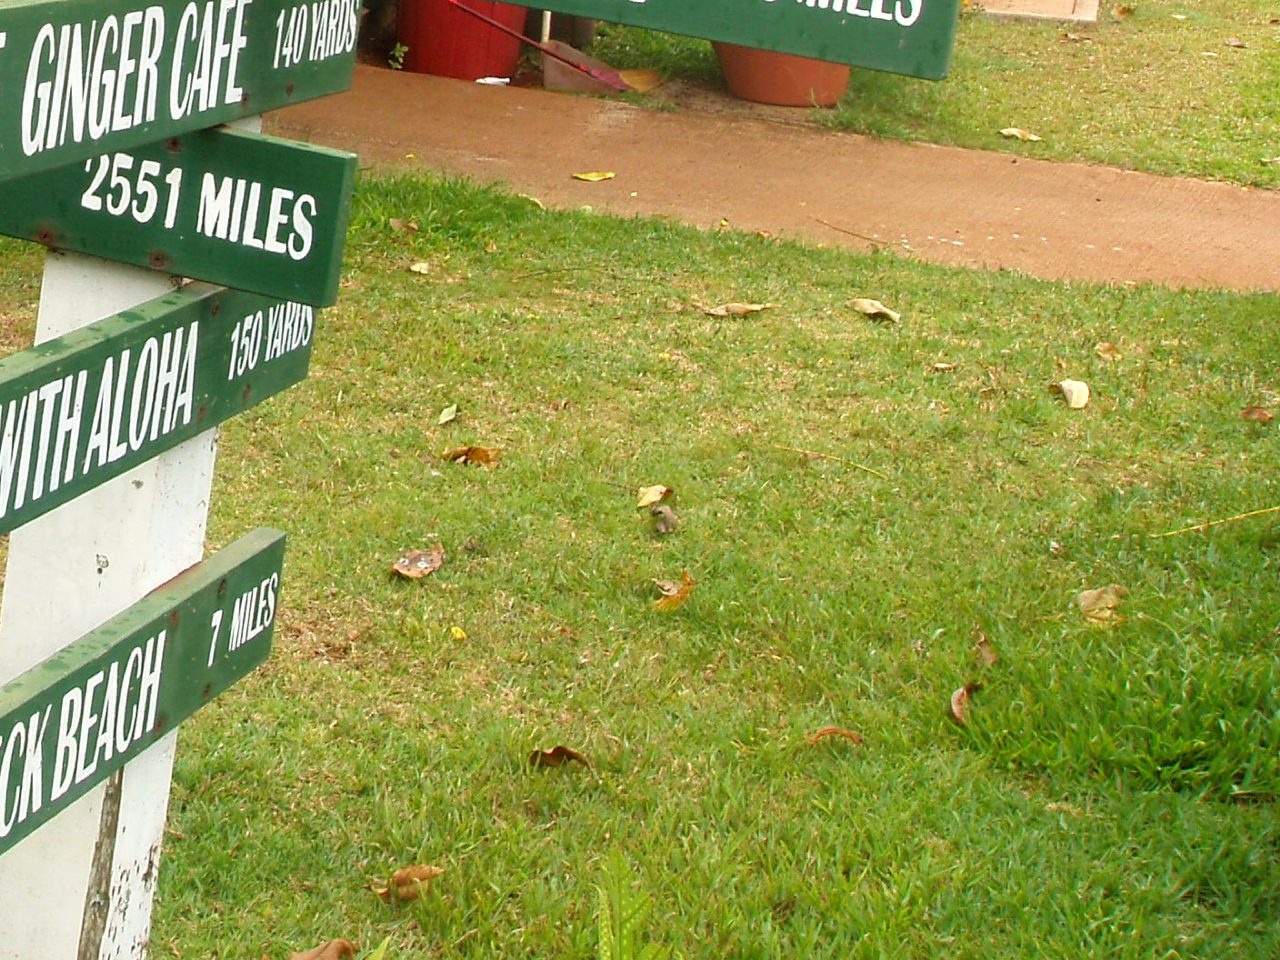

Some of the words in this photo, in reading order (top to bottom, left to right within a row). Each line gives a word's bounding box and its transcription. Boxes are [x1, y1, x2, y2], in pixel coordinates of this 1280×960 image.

[20, 5, 165, 157] GINGER
[273, 2, 308, 69] 140
[81, 152, 183, 229] 2551
[196, 172, 317, 261] MILES
[83, 321, 199, 475] ALOHA
[228, 316, 261, 380] 150
[264, 301, 313, 362] YARDS
[51, 630, 167, 801] BEACH
[207, 609, 222, 668] 7
[228, 572, 278, 652] MILES
